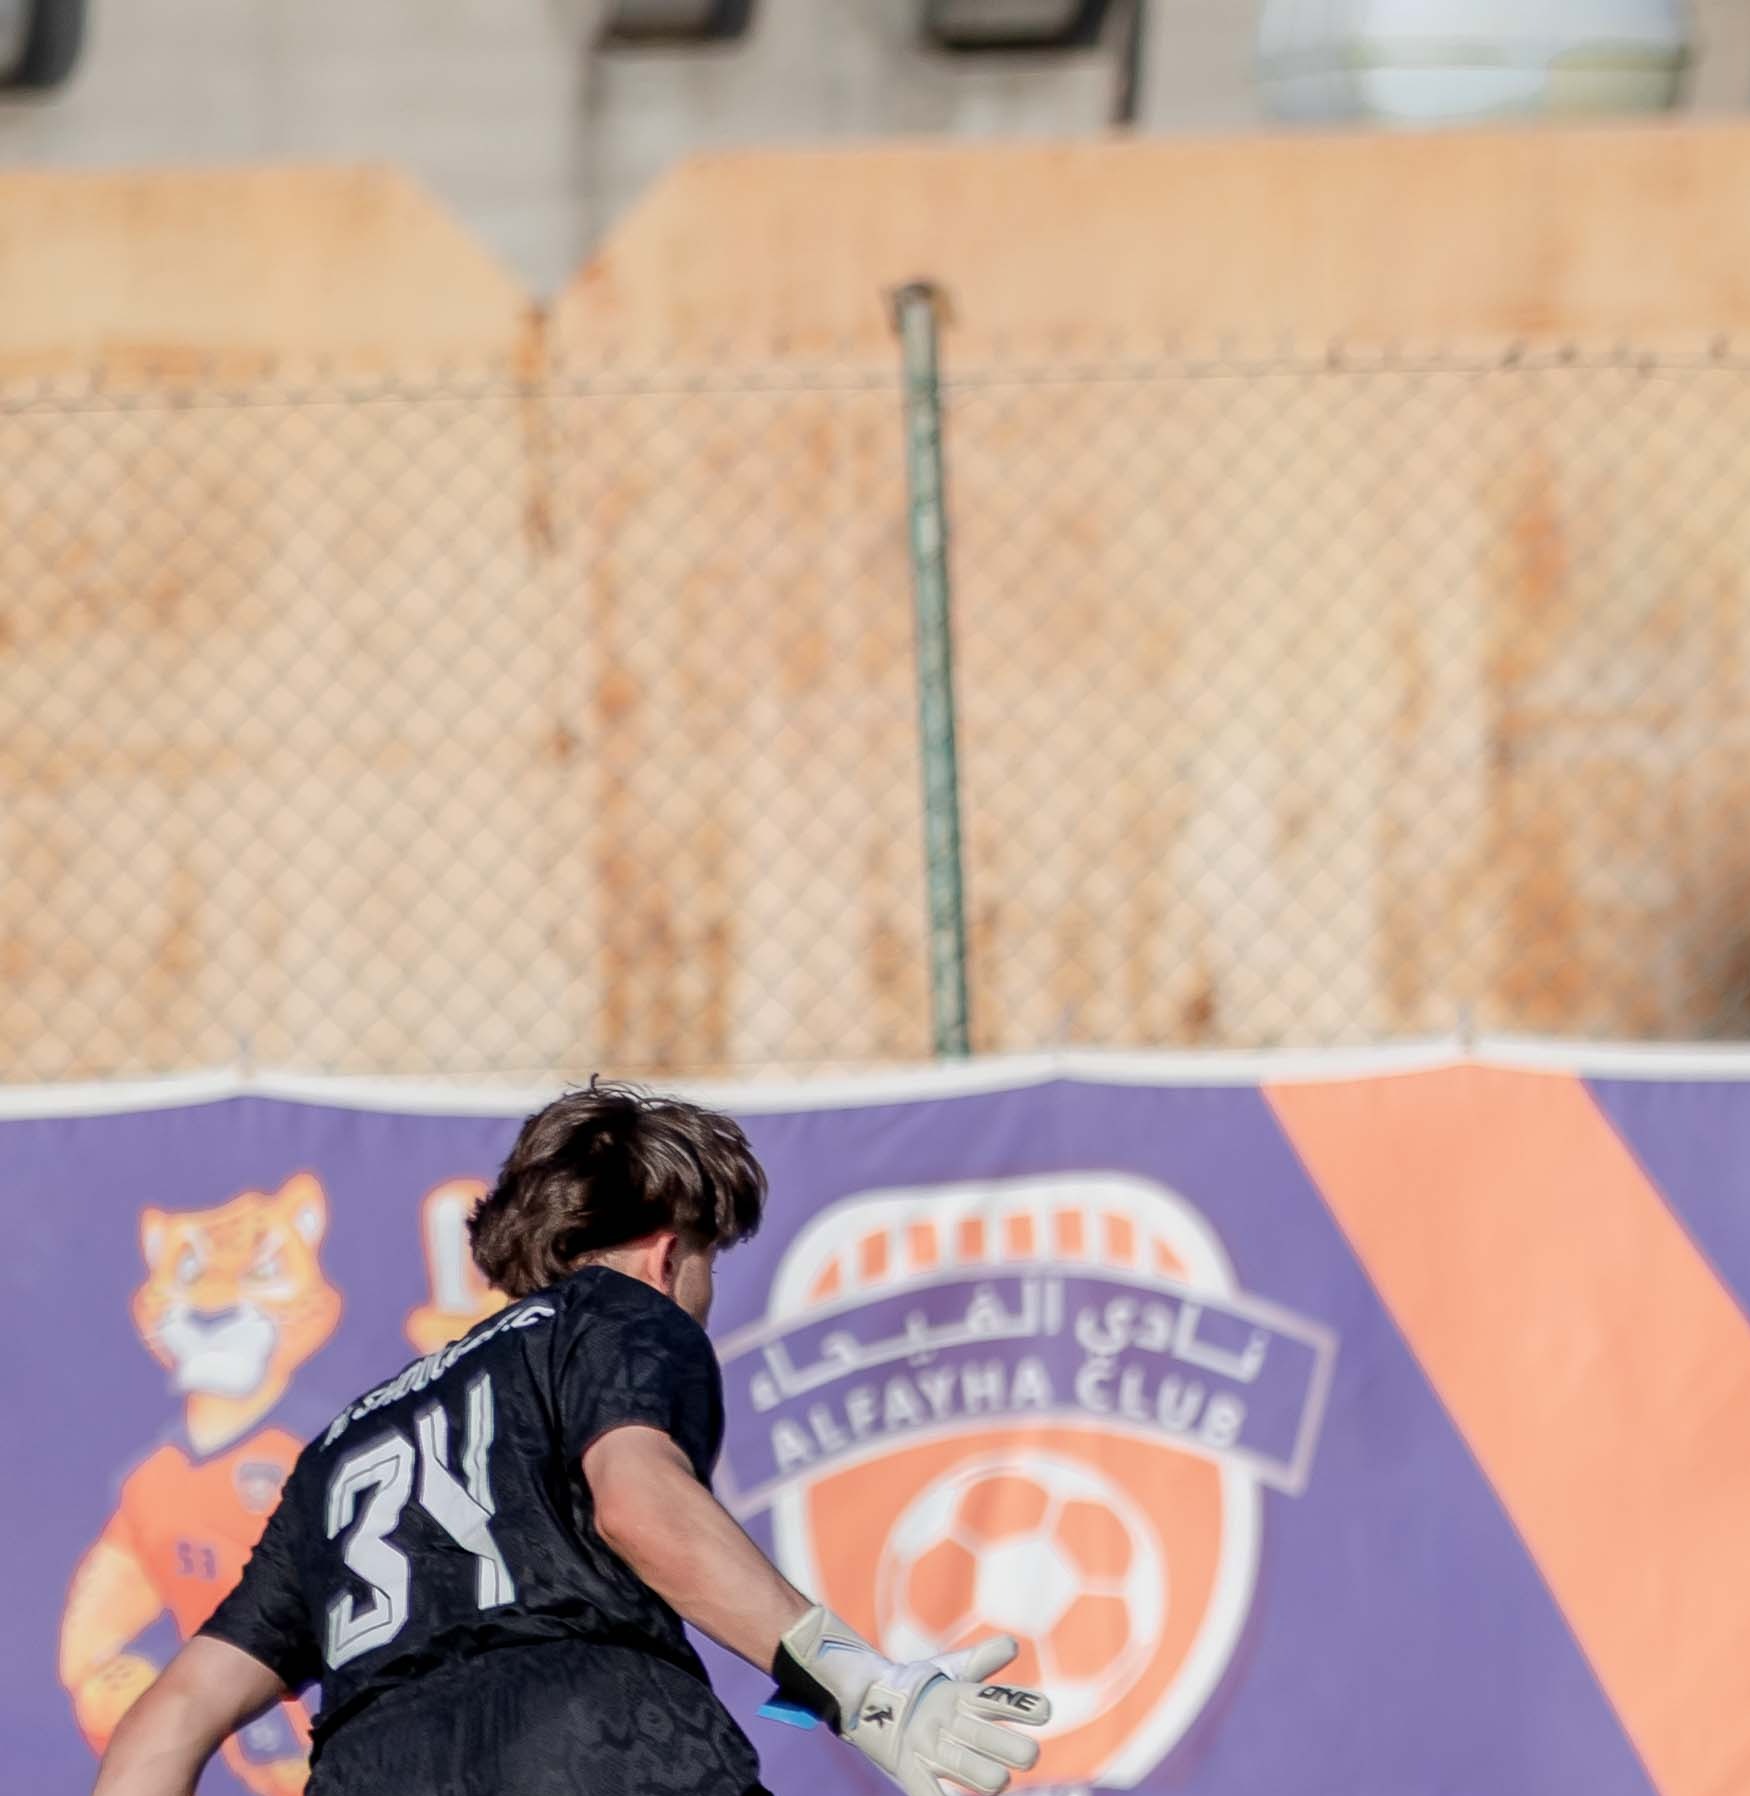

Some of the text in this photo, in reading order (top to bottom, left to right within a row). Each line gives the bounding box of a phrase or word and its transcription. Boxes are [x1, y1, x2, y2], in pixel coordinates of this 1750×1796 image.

[749, 1275, 1273, 1413] نادي الفيحاء
[770, 1355, 1245, 1474] ALFAYHA CLUB
[325, 1372, 517, 1671] 34
[977, 1685, 1042, 1714] ONE
